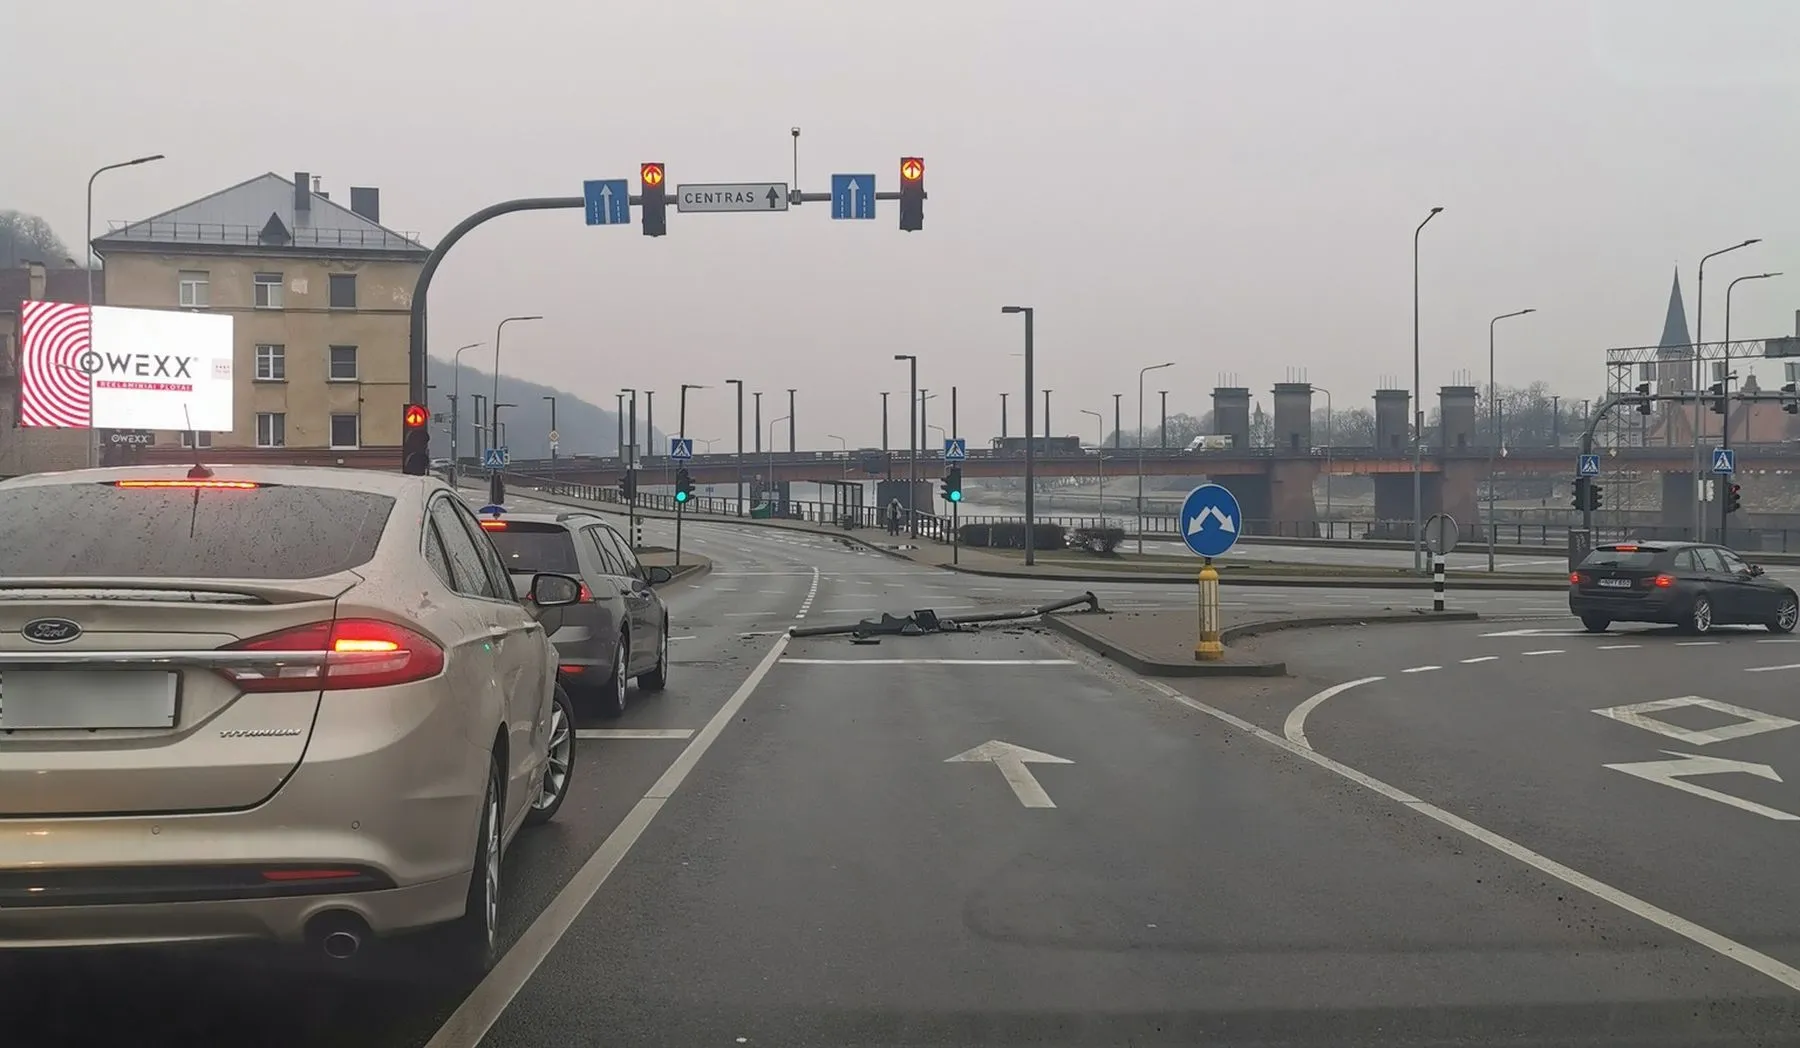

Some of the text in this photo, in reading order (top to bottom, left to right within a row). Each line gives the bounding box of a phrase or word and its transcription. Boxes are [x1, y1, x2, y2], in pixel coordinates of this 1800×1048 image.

[685, 192, 755, 204] CENTRAS
[111, 434, 148, 443] OWEXX
[33, 623, 69, 638] Ford
[220, 728, 302, 738] TITANIUM
